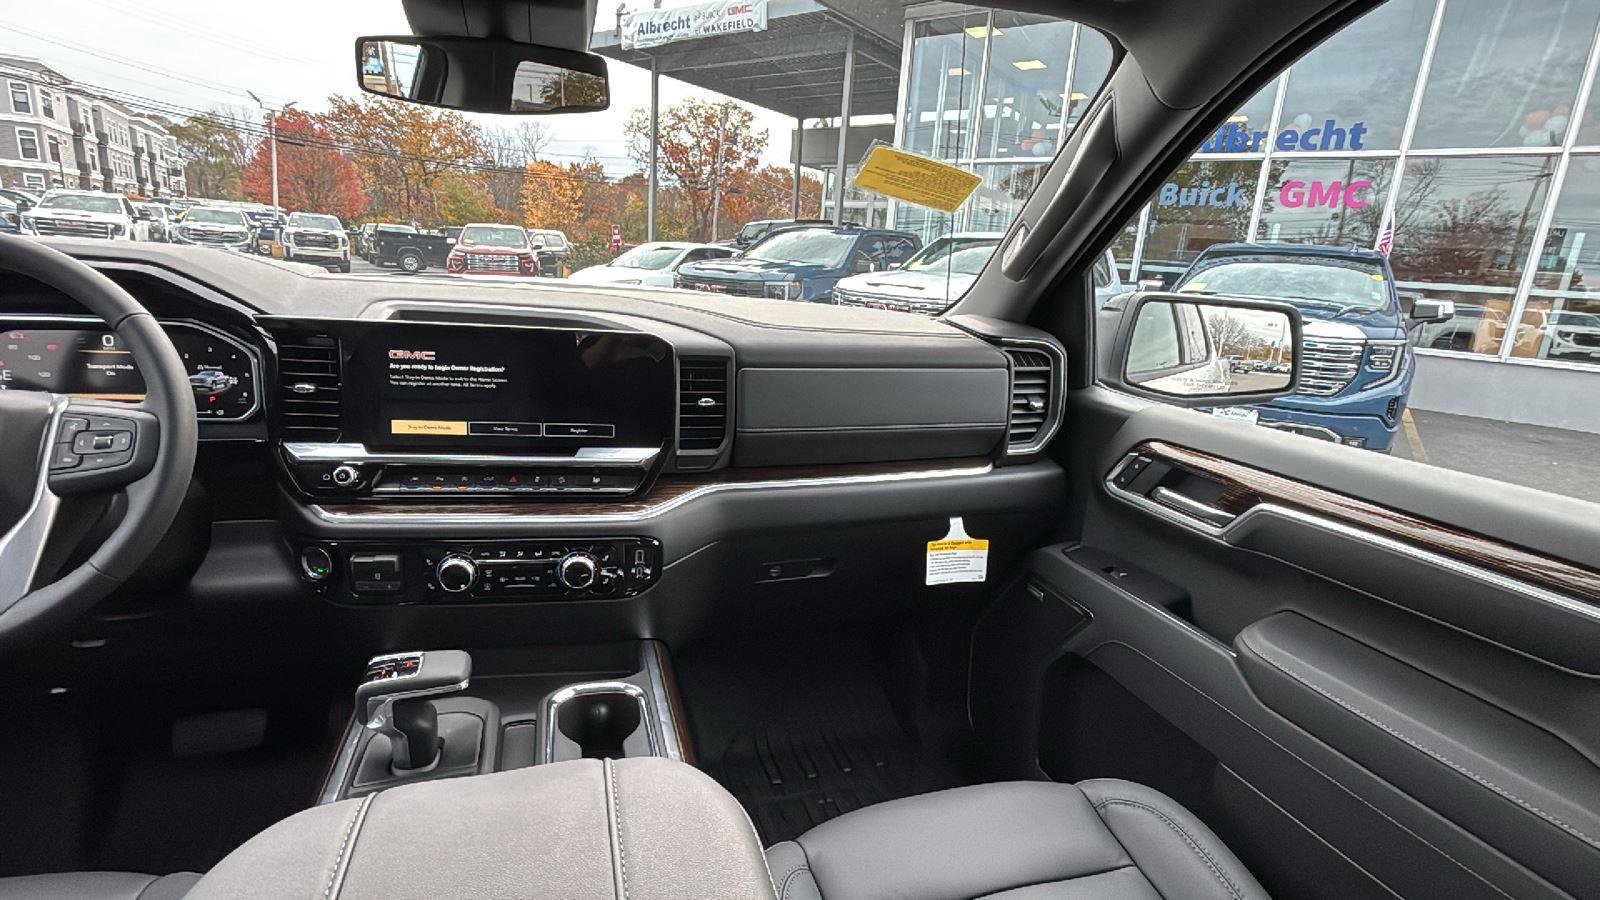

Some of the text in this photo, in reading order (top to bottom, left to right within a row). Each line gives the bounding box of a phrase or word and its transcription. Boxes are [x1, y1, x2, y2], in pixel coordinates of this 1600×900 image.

[637, 15, 691, 36] Albrecht
[703, 18, 754, 34] WAKEFIELD
[1201, 119, 1368, 152] lbrecht
[1158, 178, 1373, 208] Buick GMC
[389, 349, 436, 361] GMC
